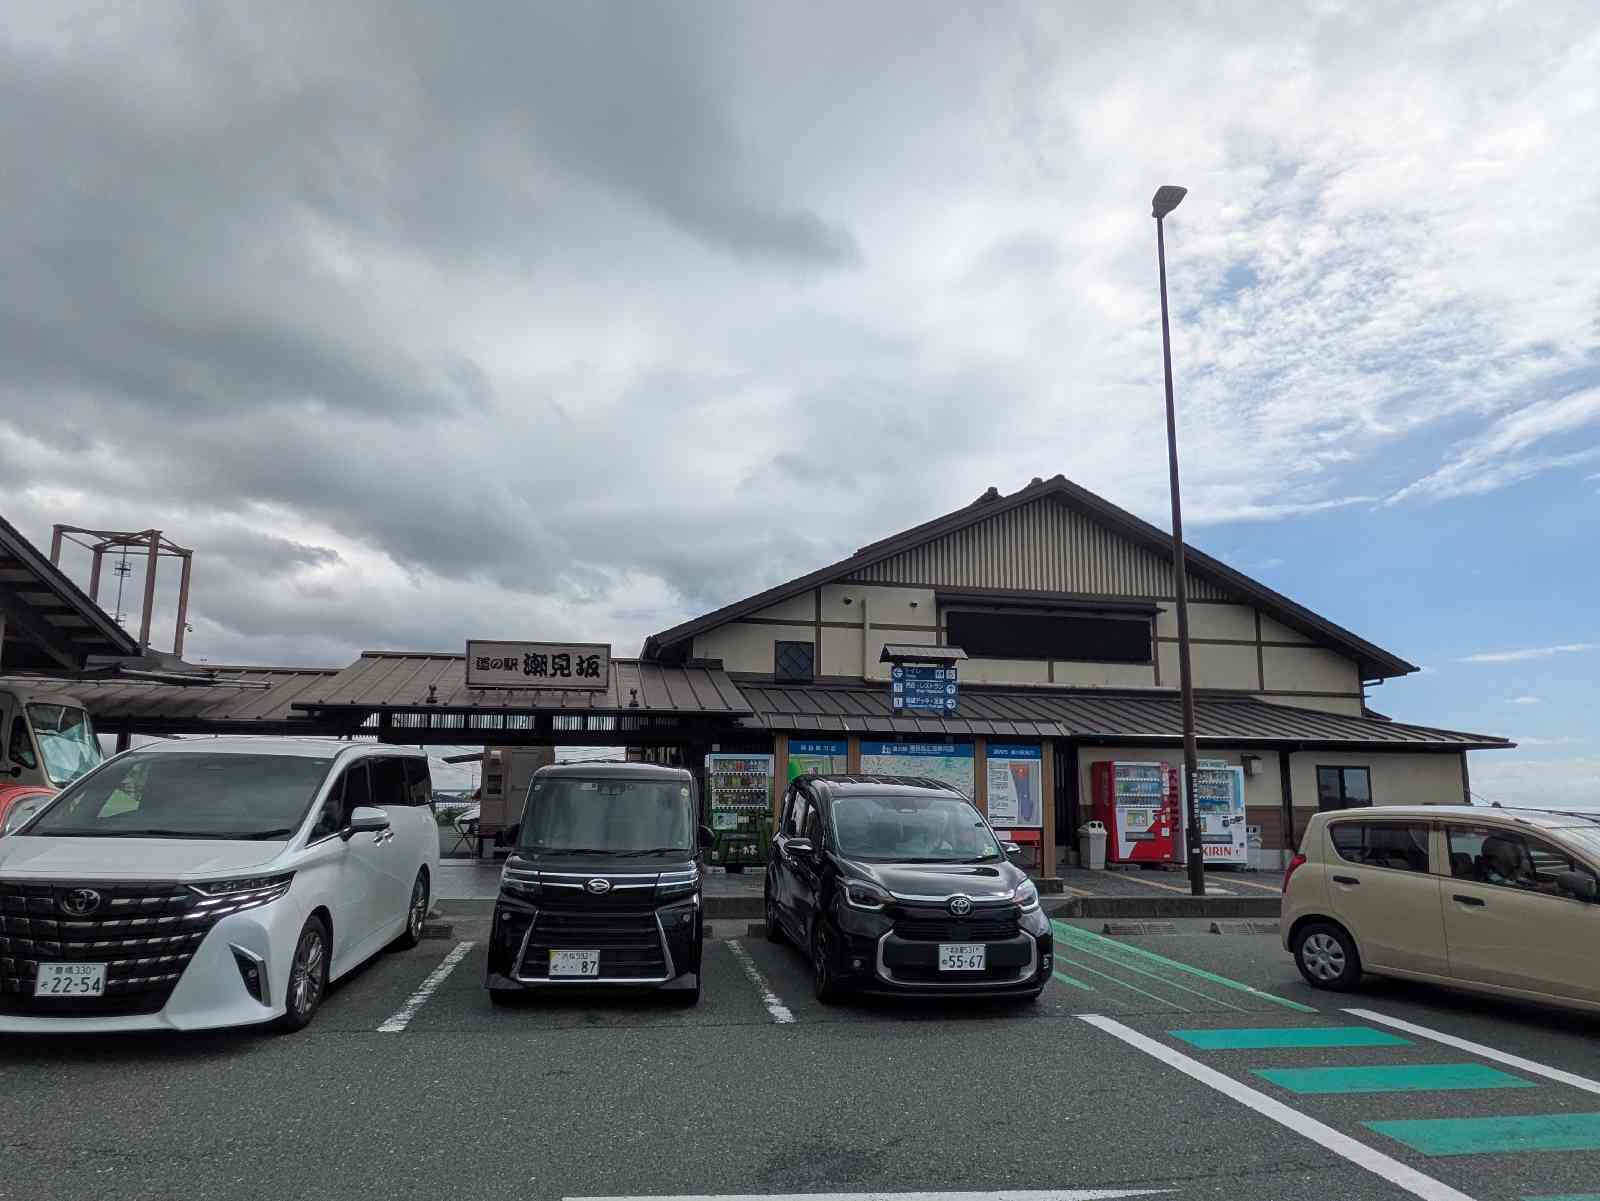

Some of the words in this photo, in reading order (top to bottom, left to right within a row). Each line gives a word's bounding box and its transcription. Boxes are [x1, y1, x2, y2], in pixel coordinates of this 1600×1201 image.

[476, 656, 519, 671] 道の駅
[523, 652, 600, 678] 潮見坂
[1201, 847, 1232, 856] KIRIN
[51, 976, 101, 993] 22-54
